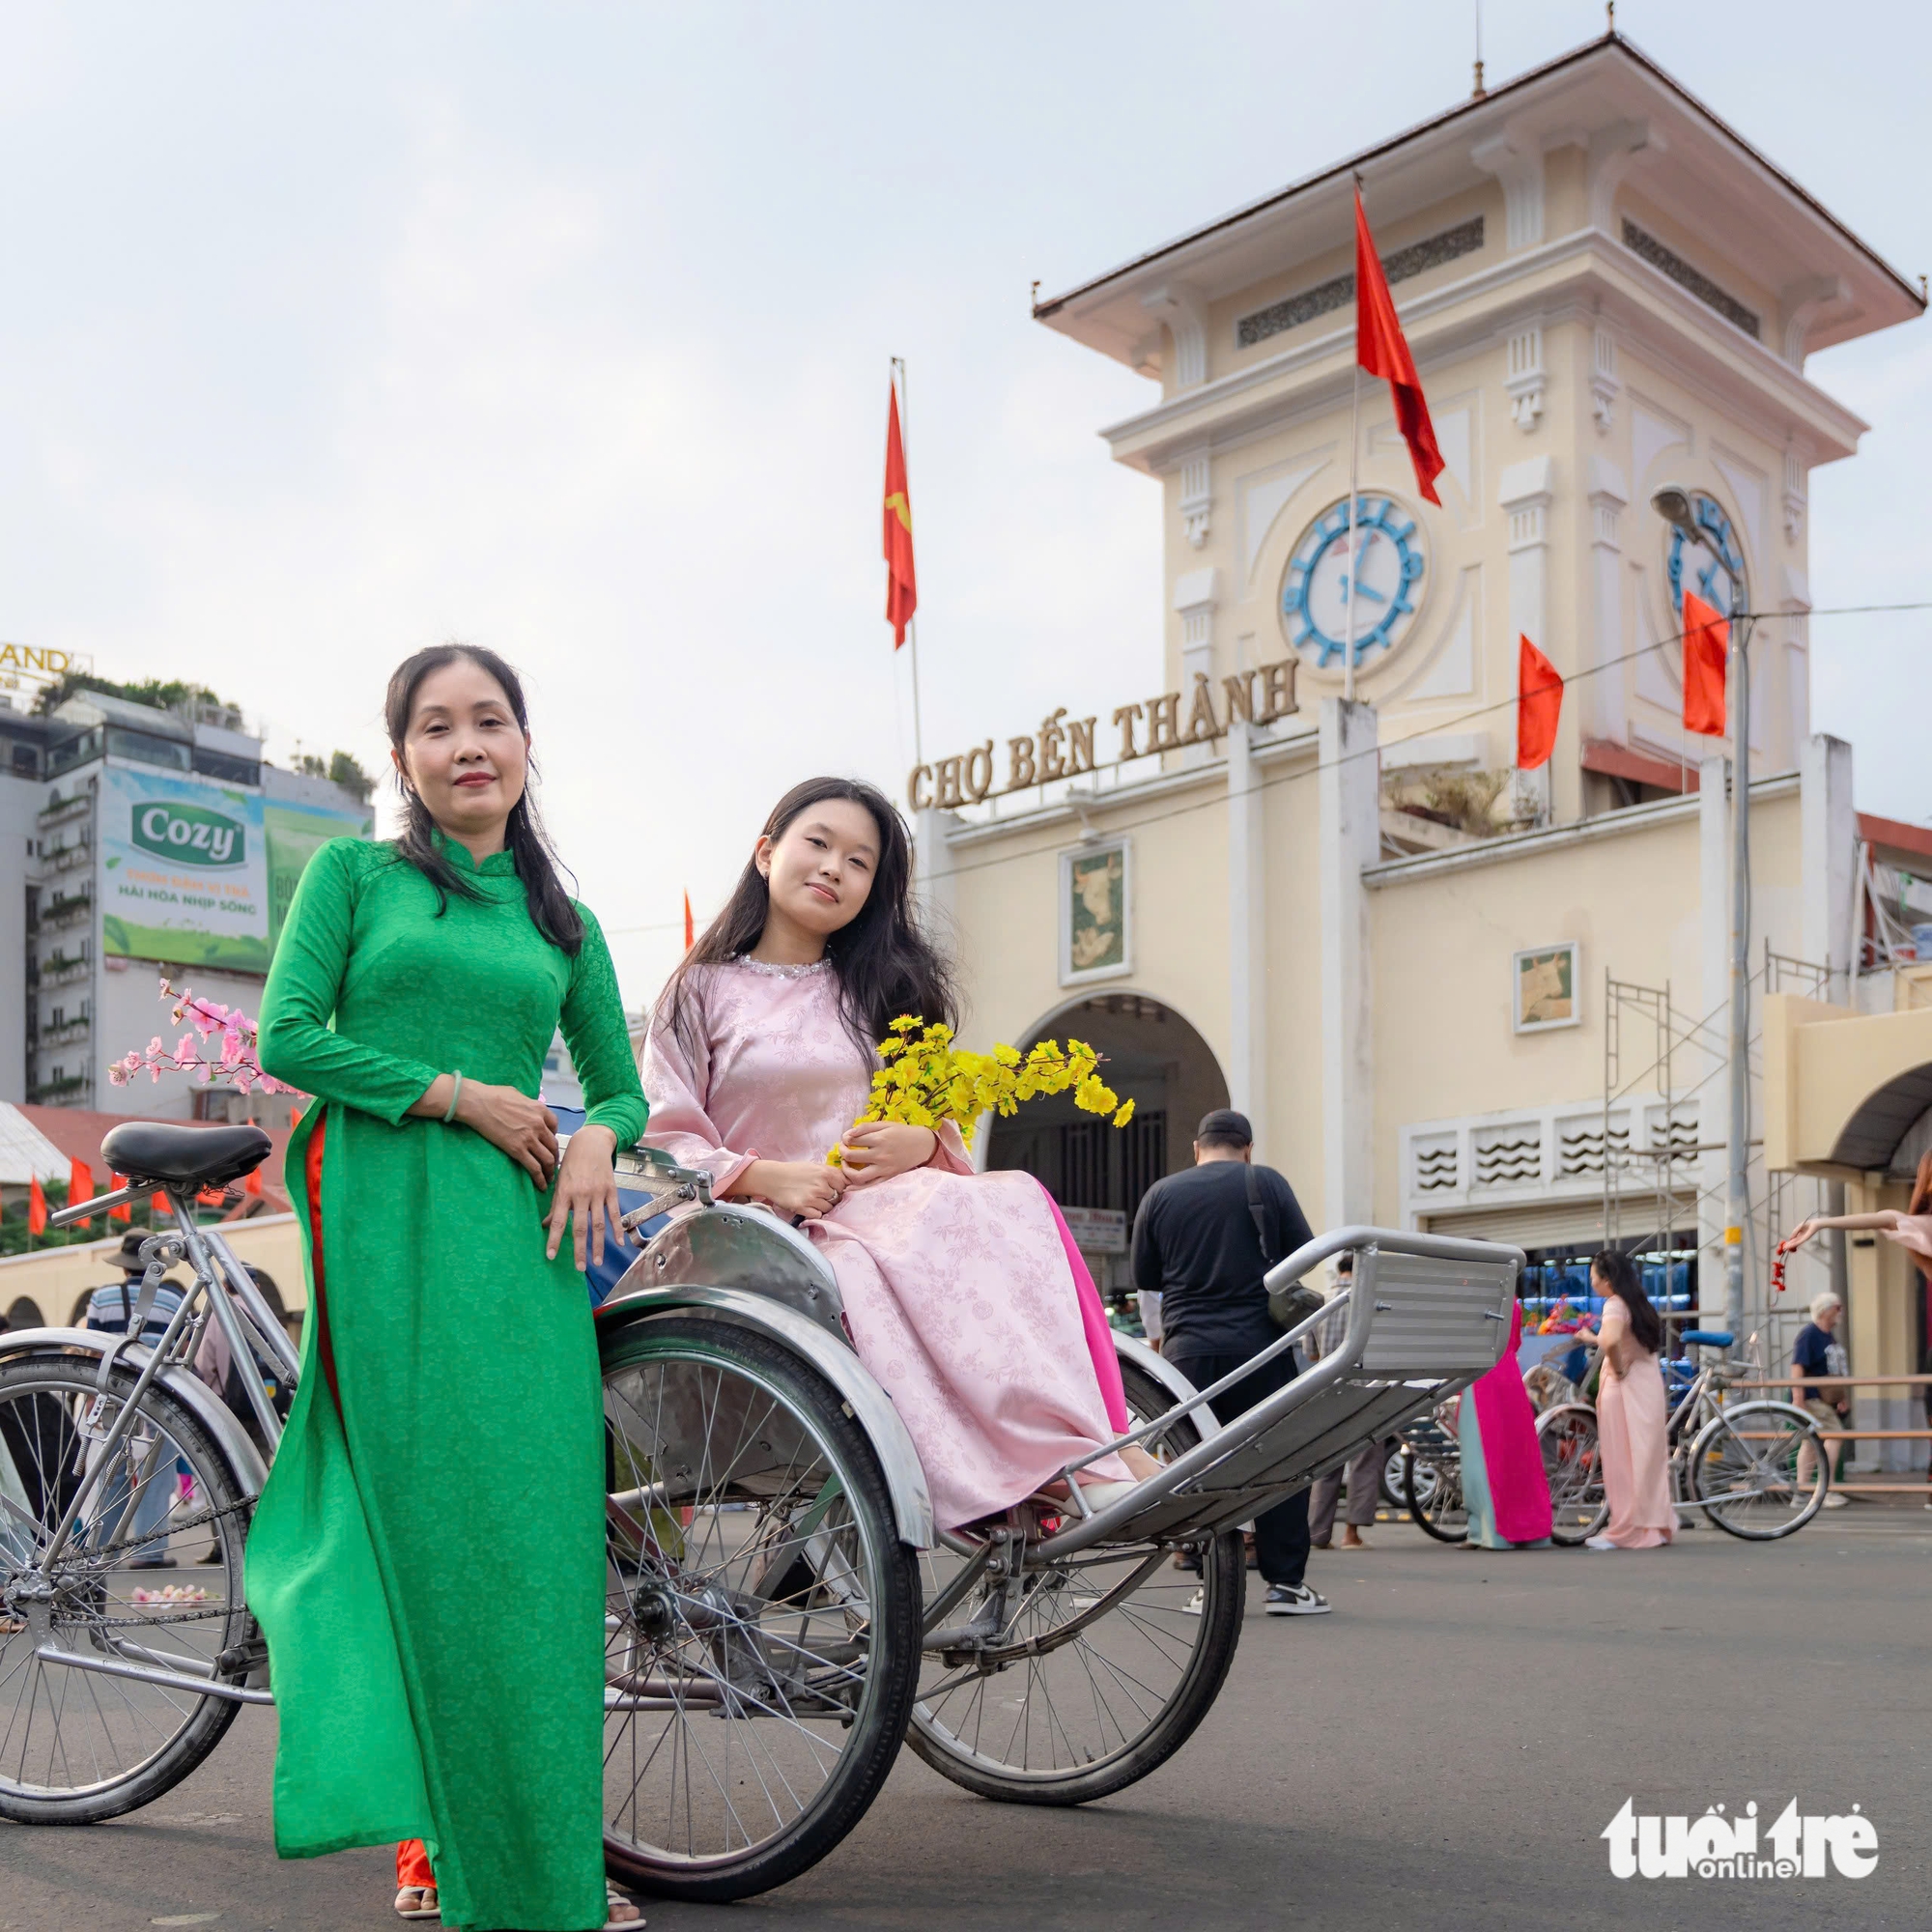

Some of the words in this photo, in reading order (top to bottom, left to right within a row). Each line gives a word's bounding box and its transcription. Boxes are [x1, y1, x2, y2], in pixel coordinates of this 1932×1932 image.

[0, 643, 69, 674] AND
[907, 738, 994, 812] CHỢ
[1008, 707, 1097, 791] BẾN
[1113, 658, 1300, 761] THÀNH
[141, 808, 235, 862] Cozy
